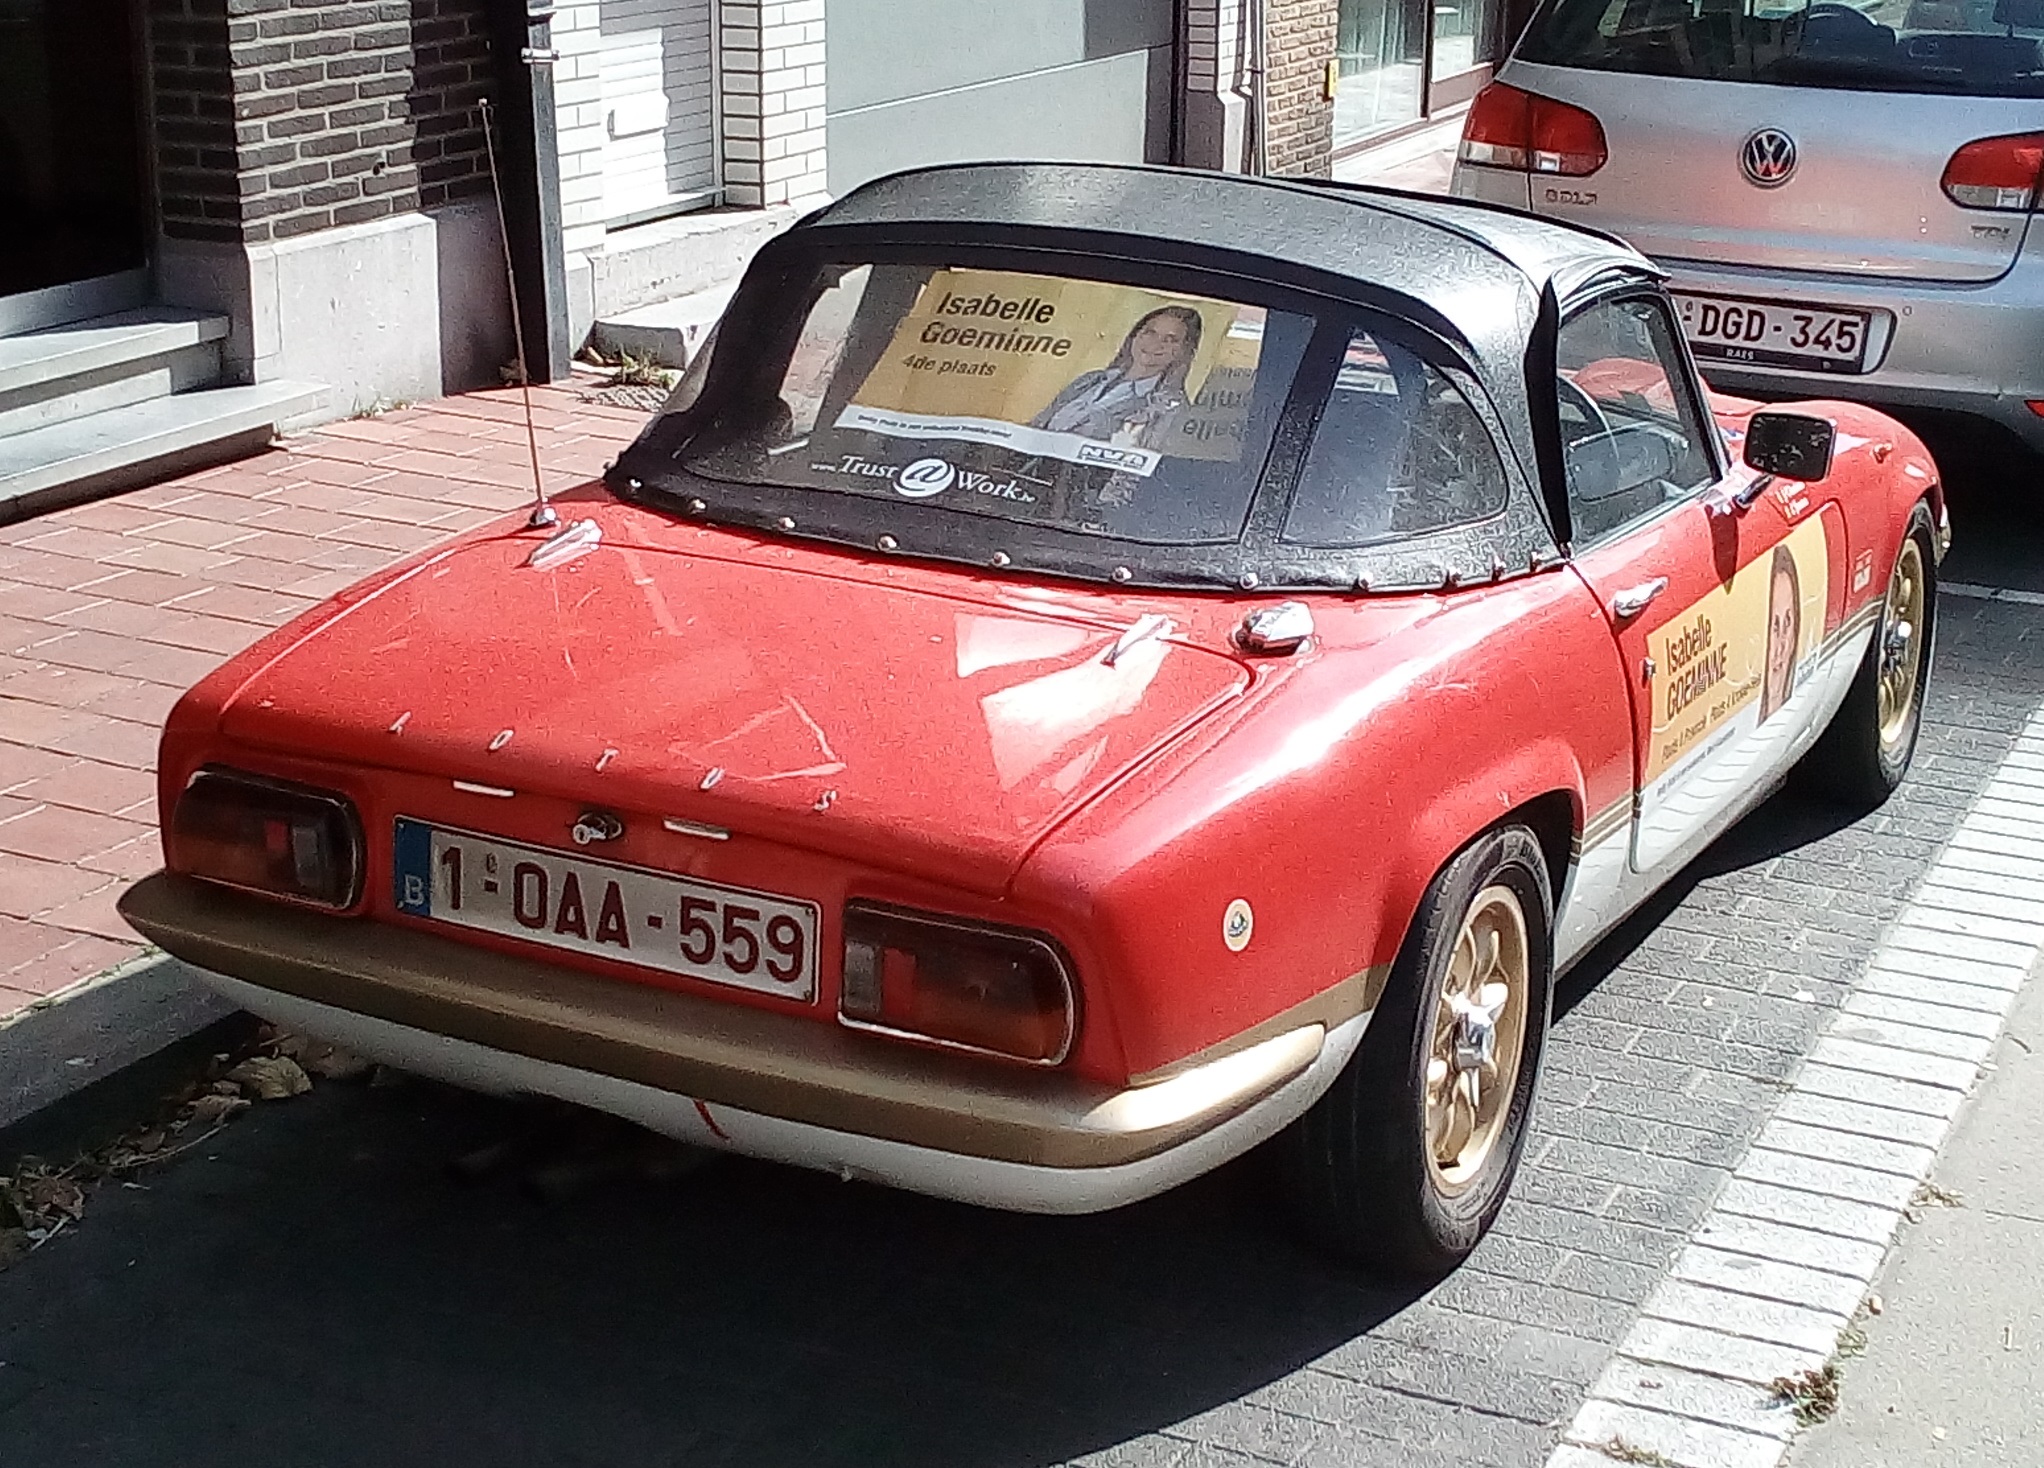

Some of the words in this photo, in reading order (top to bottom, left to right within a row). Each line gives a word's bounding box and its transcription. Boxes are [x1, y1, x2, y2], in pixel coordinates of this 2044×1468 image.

[937, 291, 1055, 324] Isabelle
[920, 321, 1072, 357] Goeminne
[902, 353, 937, 371] 4de
[937, 358, 997, 377] plaats
[1665, 613, 1713, 677] Isabelle
[1666, 641, 1728, 722] GOEMINNE
[403, 873, 425, 907] B
